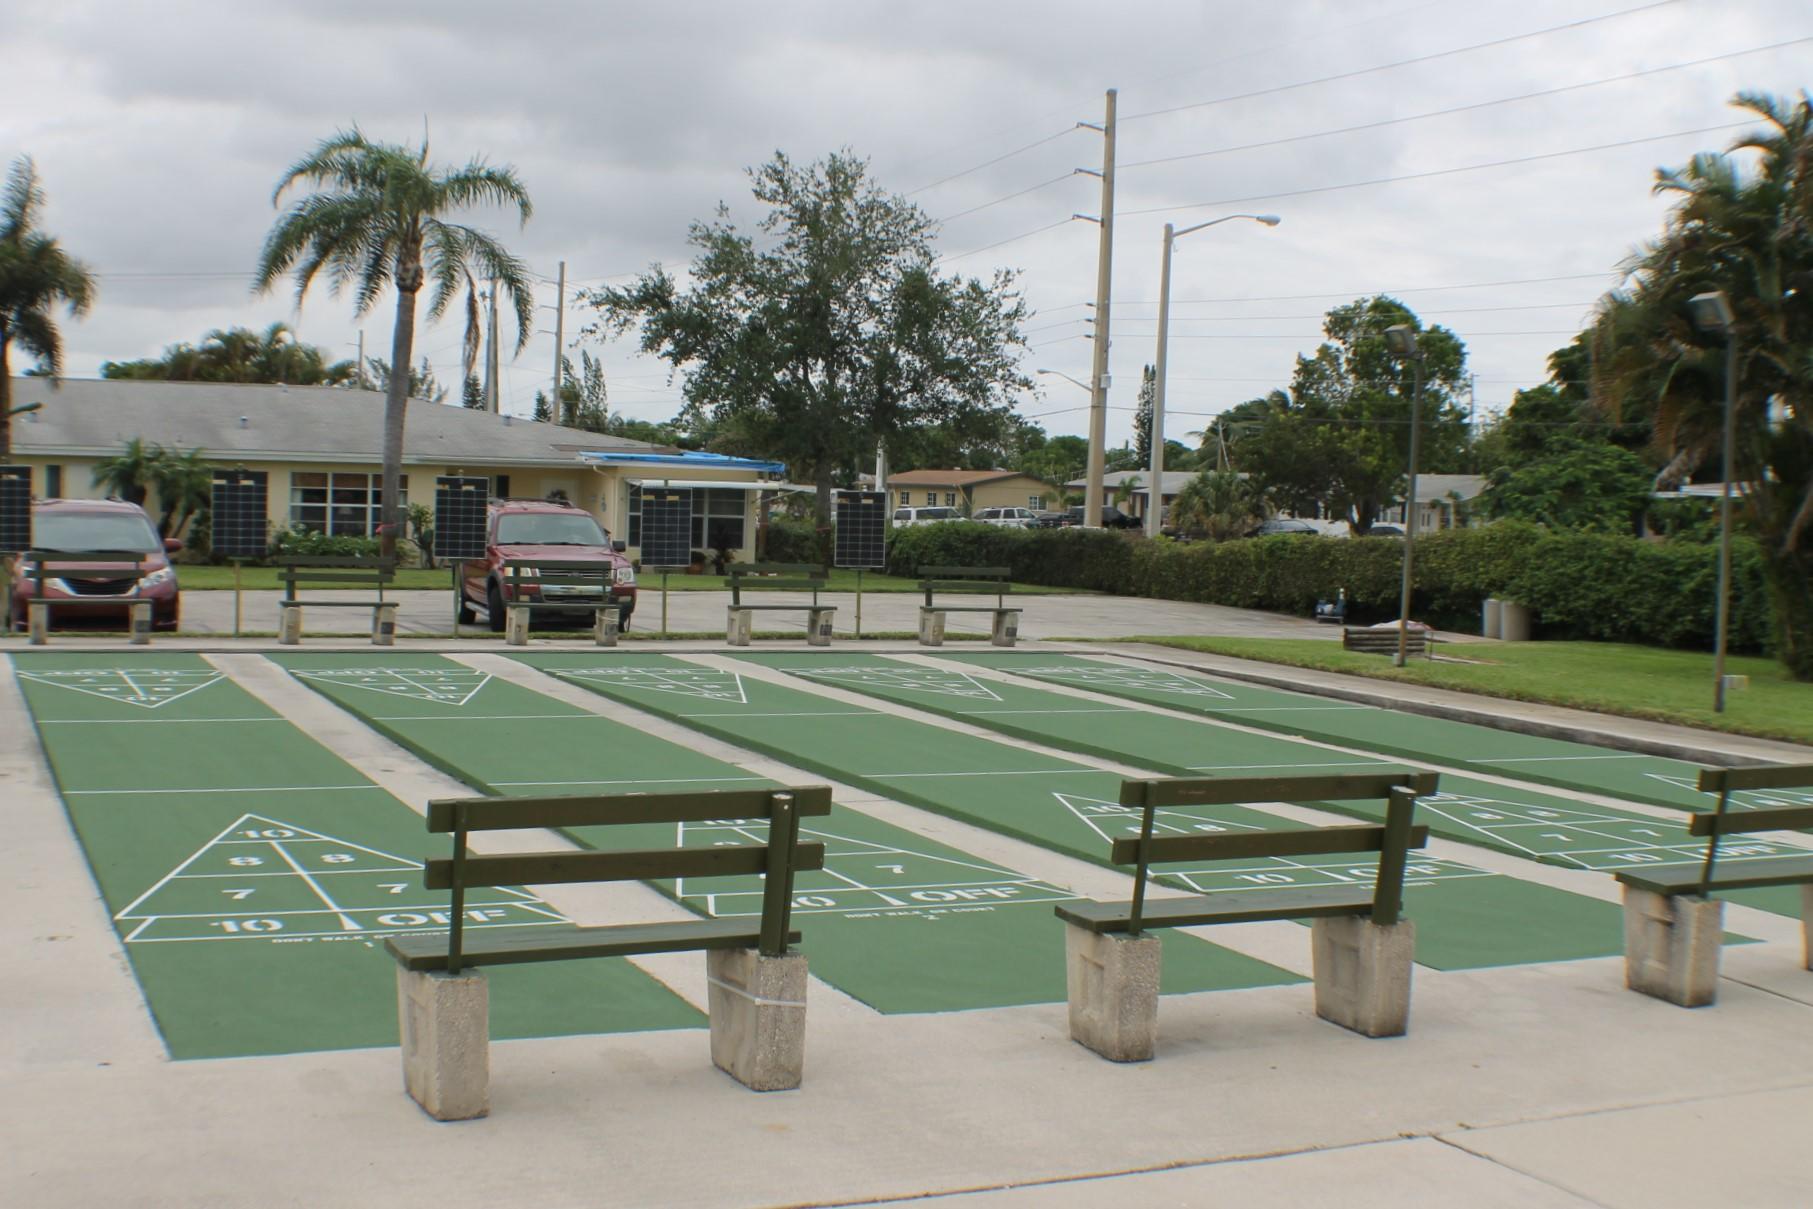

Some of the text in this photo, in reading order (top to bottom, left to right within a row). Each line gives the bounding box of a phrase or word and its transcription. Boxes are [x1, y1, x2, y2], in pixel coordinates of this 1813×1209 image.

[237, 828, 296, 839] 10
[229, 853, 356, 867] 8 8
[875, 864, 904, 874] 7
[1234, 873, 1296, 884] 10
[221, 883, 409, 900] 7 7
[910, 886, 1022, 902] OFF
[209, 918, 284, 934] 10
